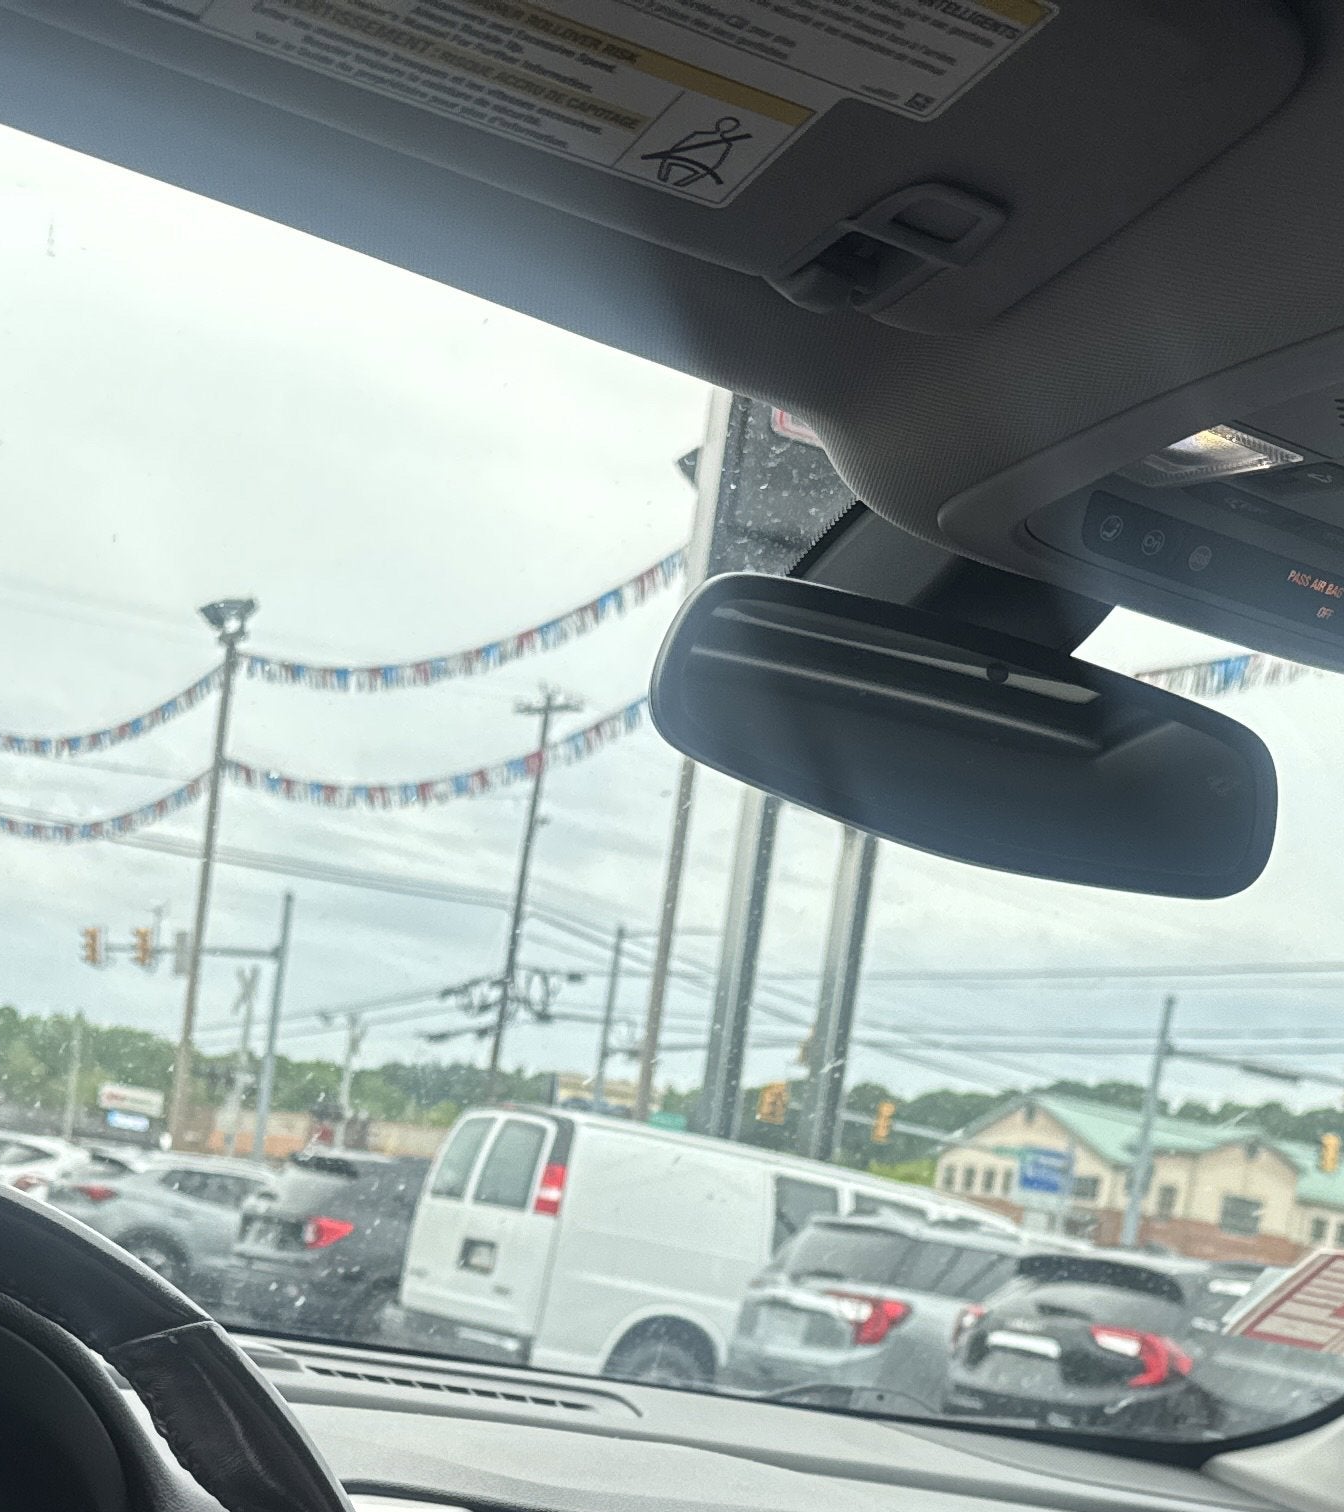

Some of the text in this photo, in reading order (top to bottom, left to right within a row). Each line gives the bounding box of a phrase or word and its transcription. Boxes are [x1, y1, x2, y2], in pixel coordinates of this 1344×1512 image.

[1287, 569, 1344, 599] PASS AIR BAG
[1316, 606, 1335, 620] OFF
